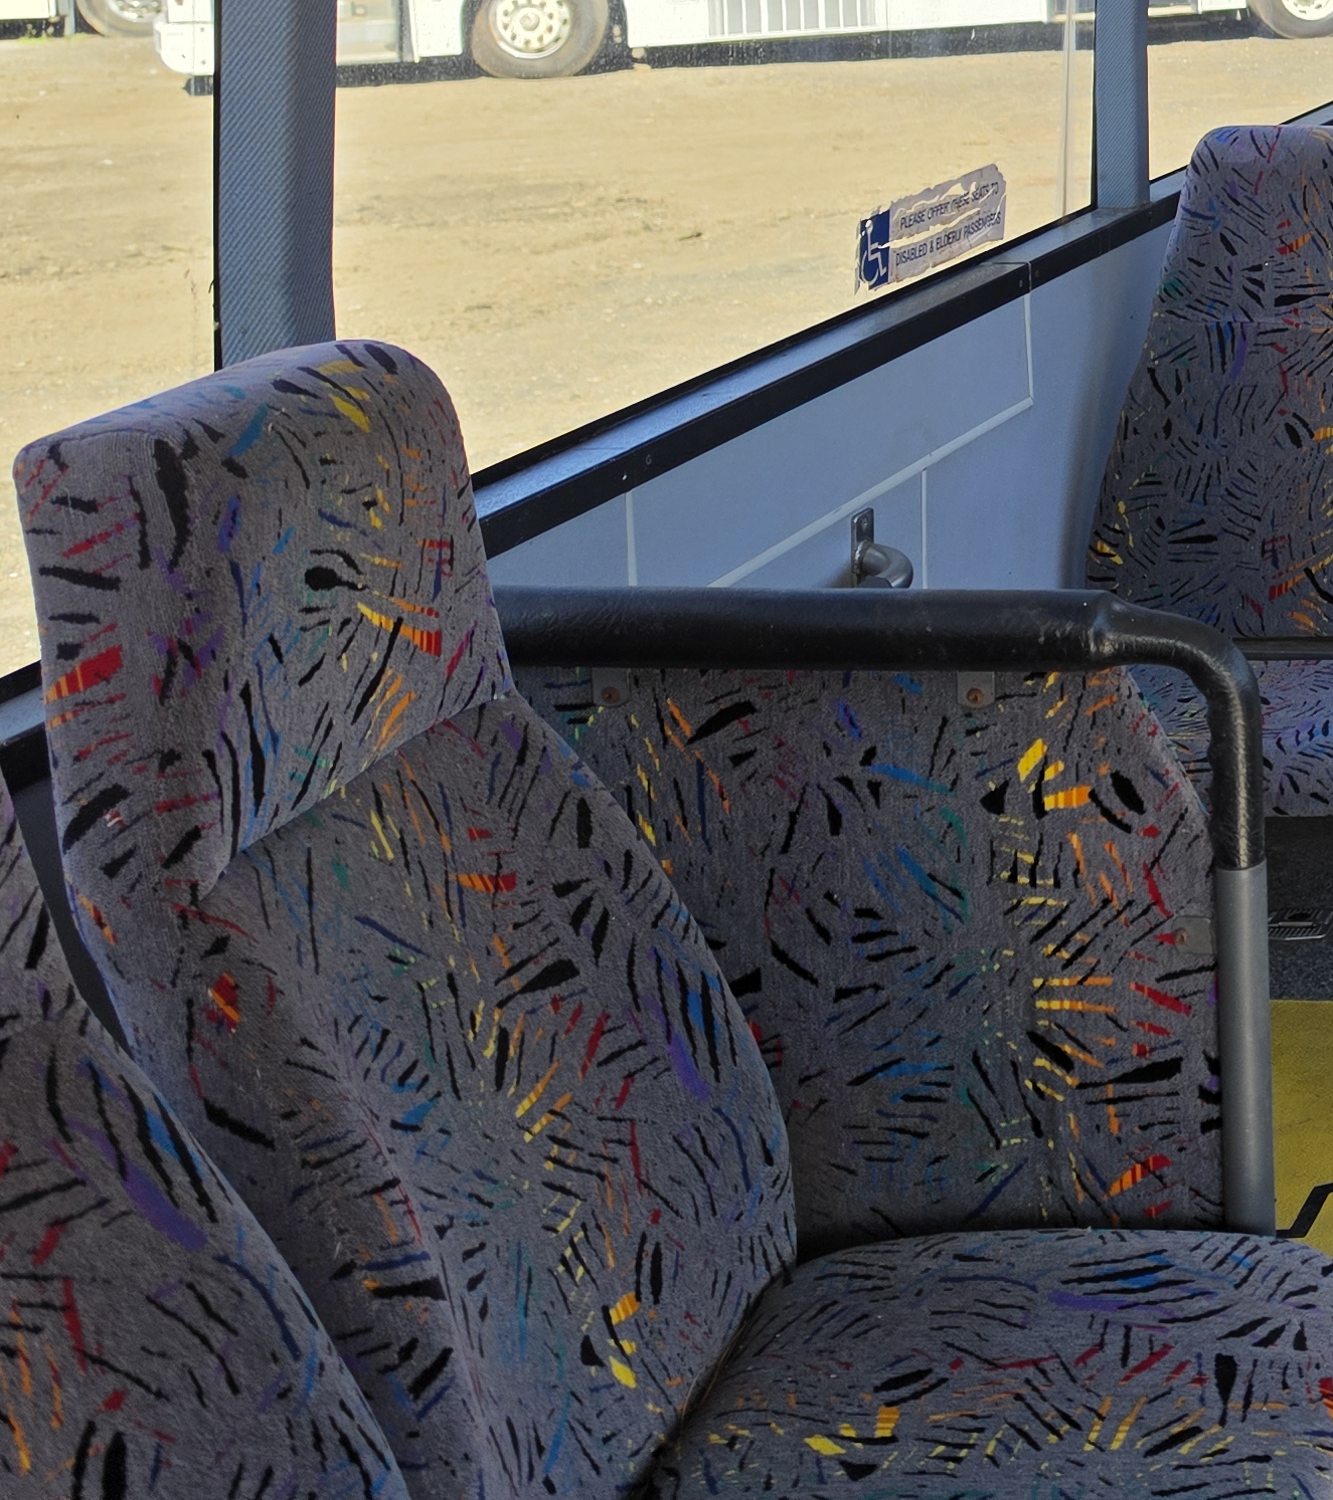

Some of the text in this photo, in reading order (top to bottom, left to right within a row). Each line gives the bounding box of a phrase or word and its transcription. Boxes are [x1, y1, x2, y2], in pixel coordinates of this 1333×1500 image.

[900, 209, 927, 230] PLEASE
[895, 243, 928, 267] DISABLED
[936, 228, 962, 251] ELDERLY
